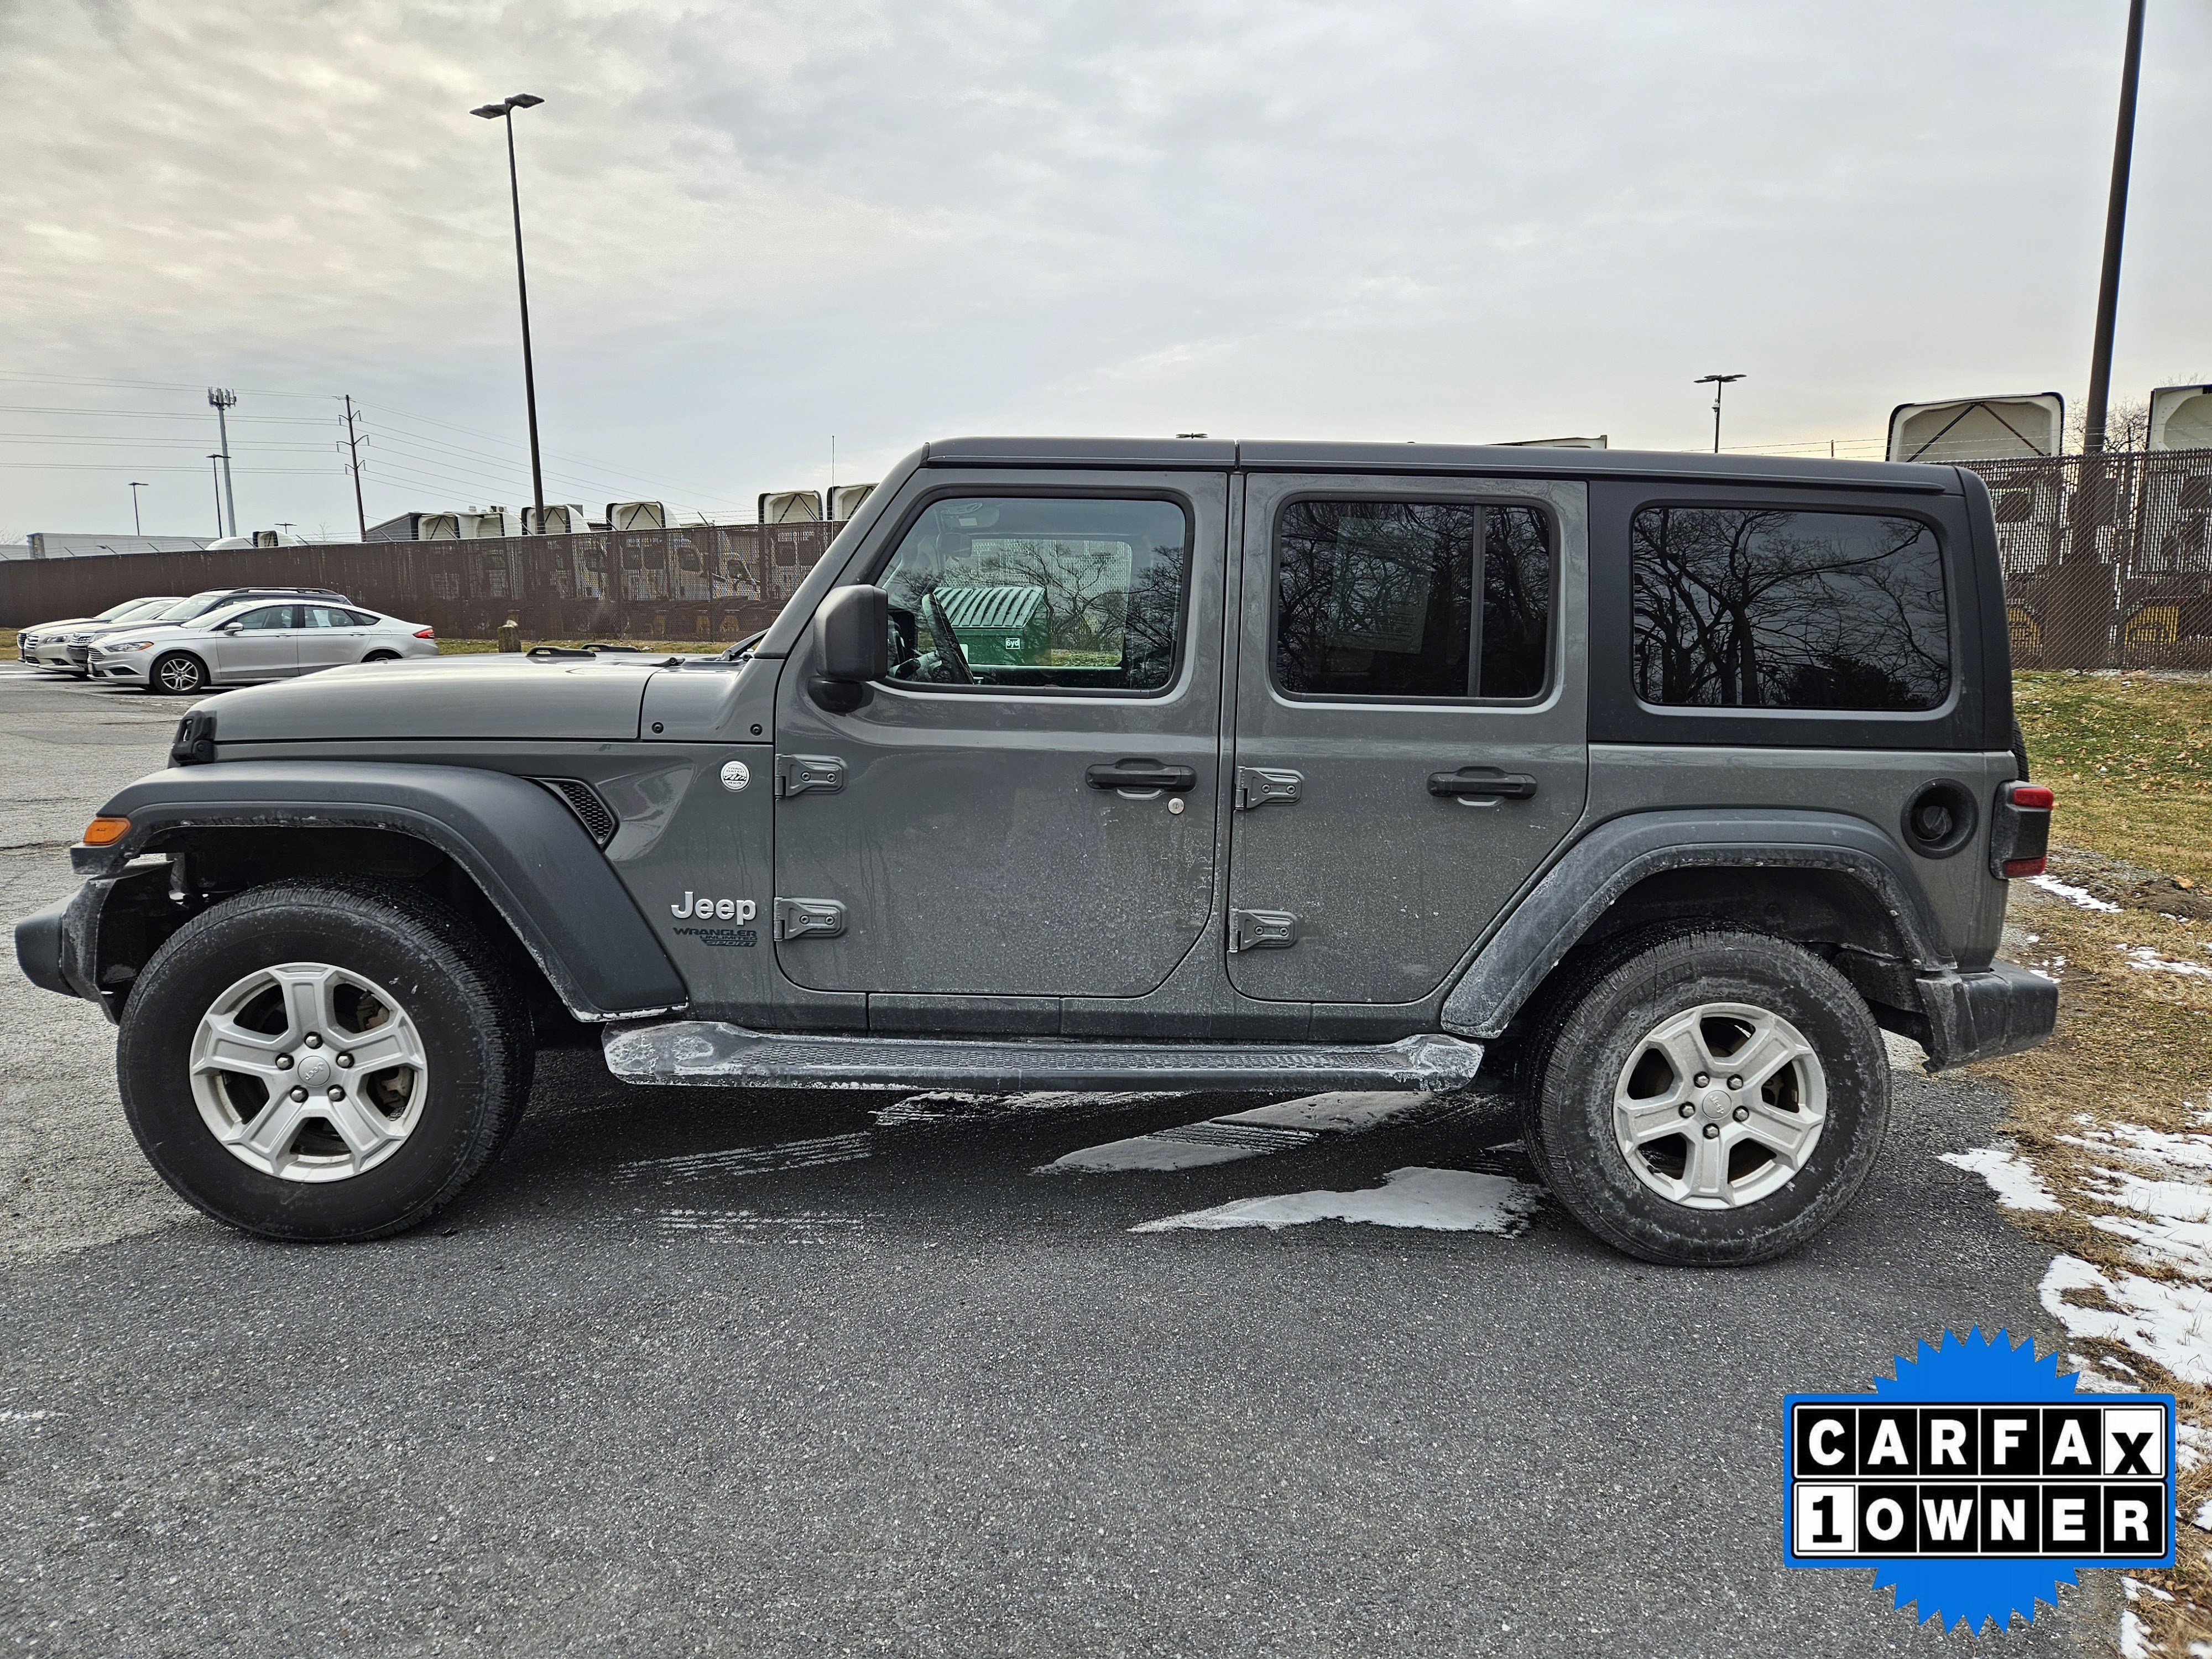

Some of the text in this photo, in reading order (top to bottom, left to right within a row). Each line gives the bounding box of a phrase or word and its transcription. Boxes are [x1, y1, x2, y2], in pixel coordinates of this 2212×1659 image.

[1006, 639, 1019, 648] 6yd
[671, 891, 757, 926] Jeep
[672, 927, 758, 937] WRANGLER
[305, 1062, 325, 1081] Jeep
[1709, 1095, 1724, 1114] Jeep
